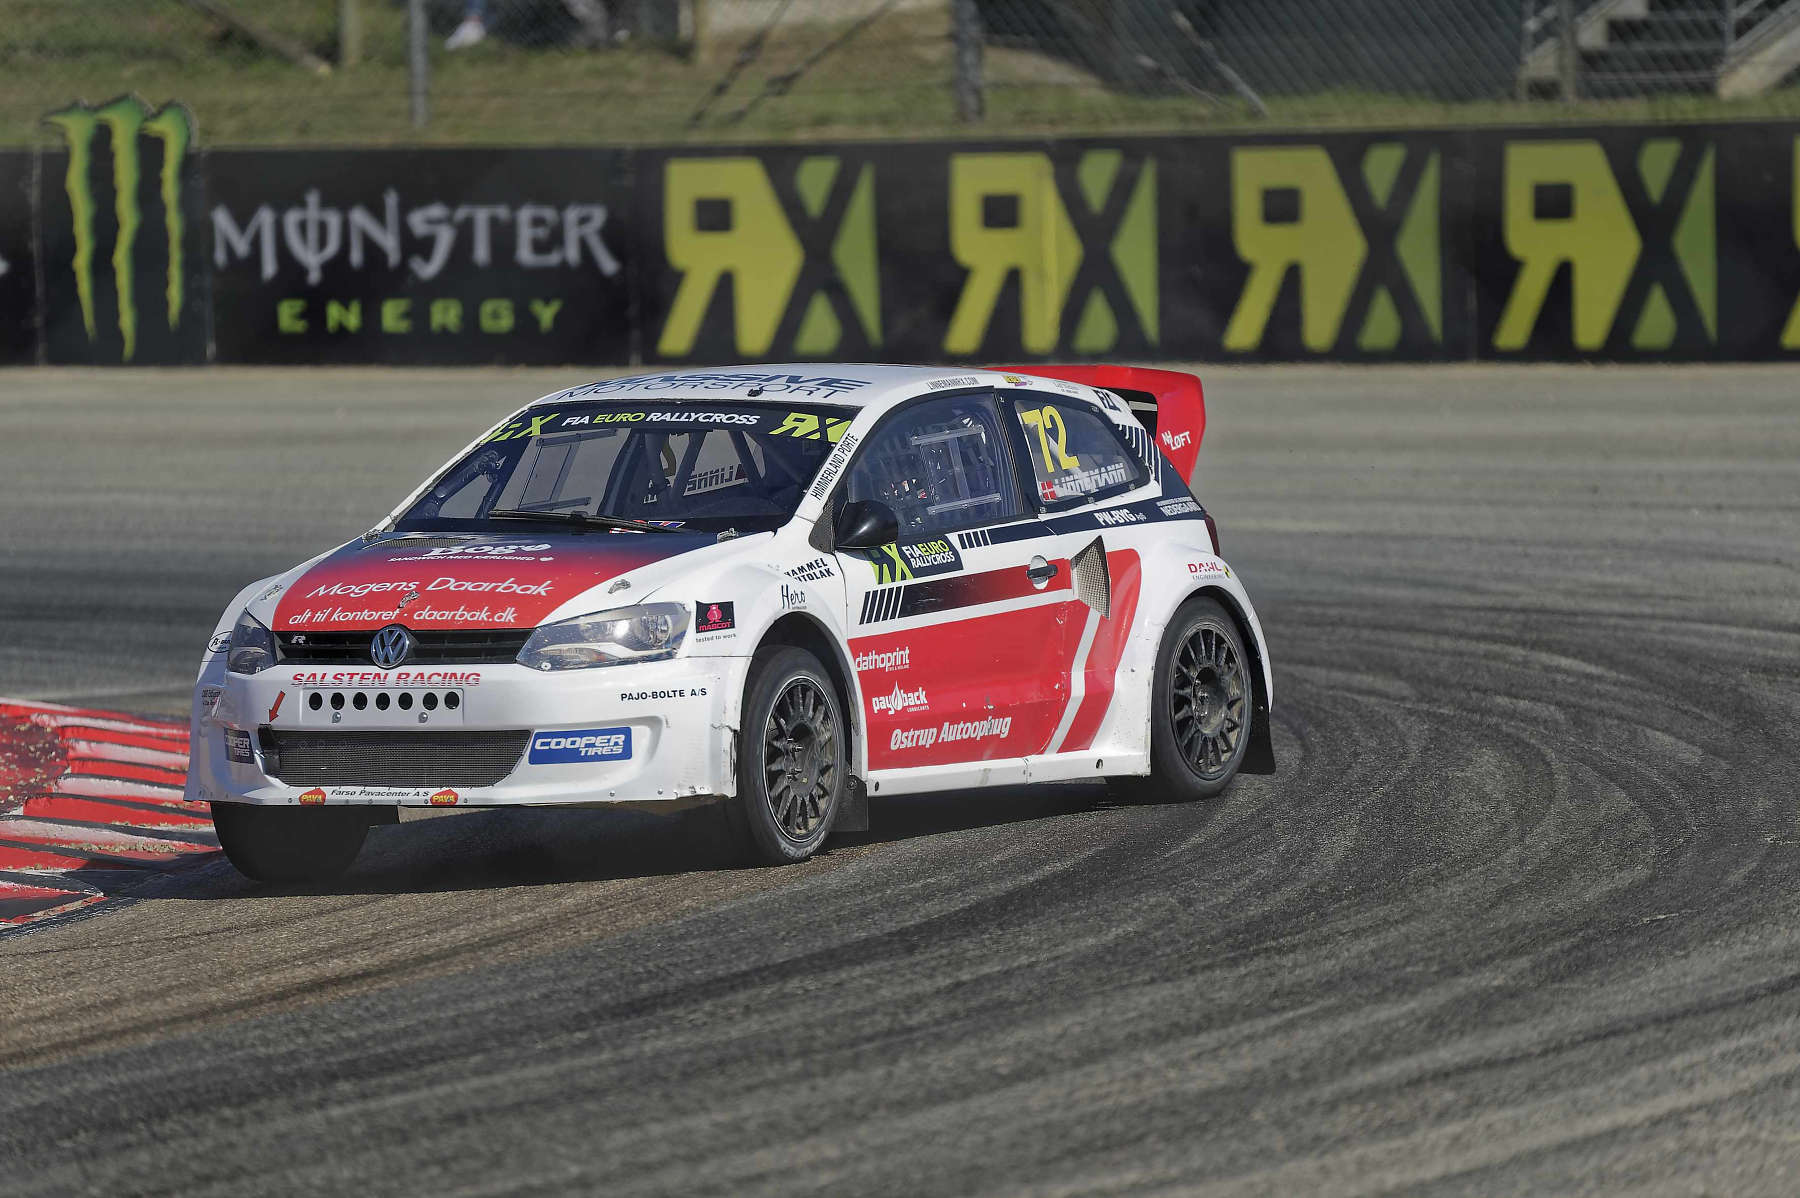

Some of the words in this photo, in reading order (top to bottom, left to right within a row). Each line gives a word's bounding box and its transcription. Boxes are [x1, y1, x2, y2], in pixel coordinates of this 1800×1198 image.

[211, 188, 621, 286] MONSTER
[277, 298, 564, 333] ENERGY
[560, 416, 590, 427] FIA
[593, 412, 646, 425] EURO
[645, 411, 761, 426] RALLYCROSS
[1021, 405, 1080, 473] 72
[909, 551, 956, 569] RALLYCROSS
[305, 581, 420, 598] Mogens
[426, 577, 556, 597] Daarbak
[288, 608, 314, 625] alt
[312, 606, 328, 622] til
[413, 605, 518, 623] daarbak.dk
[855, 646, 910, 673] dathoprint
[291, 672, 388, 687] SALSTEN
[394, 672, 481, 687] RACING
[620, 689, 686, 701] PAJO-BOLTE
[690, 687, 708, 698] A/S
[534, 734, 625, 751] COOPER
[890, 728, 938, 751] Østrup
[579, 745, 624, 756] TIRES
